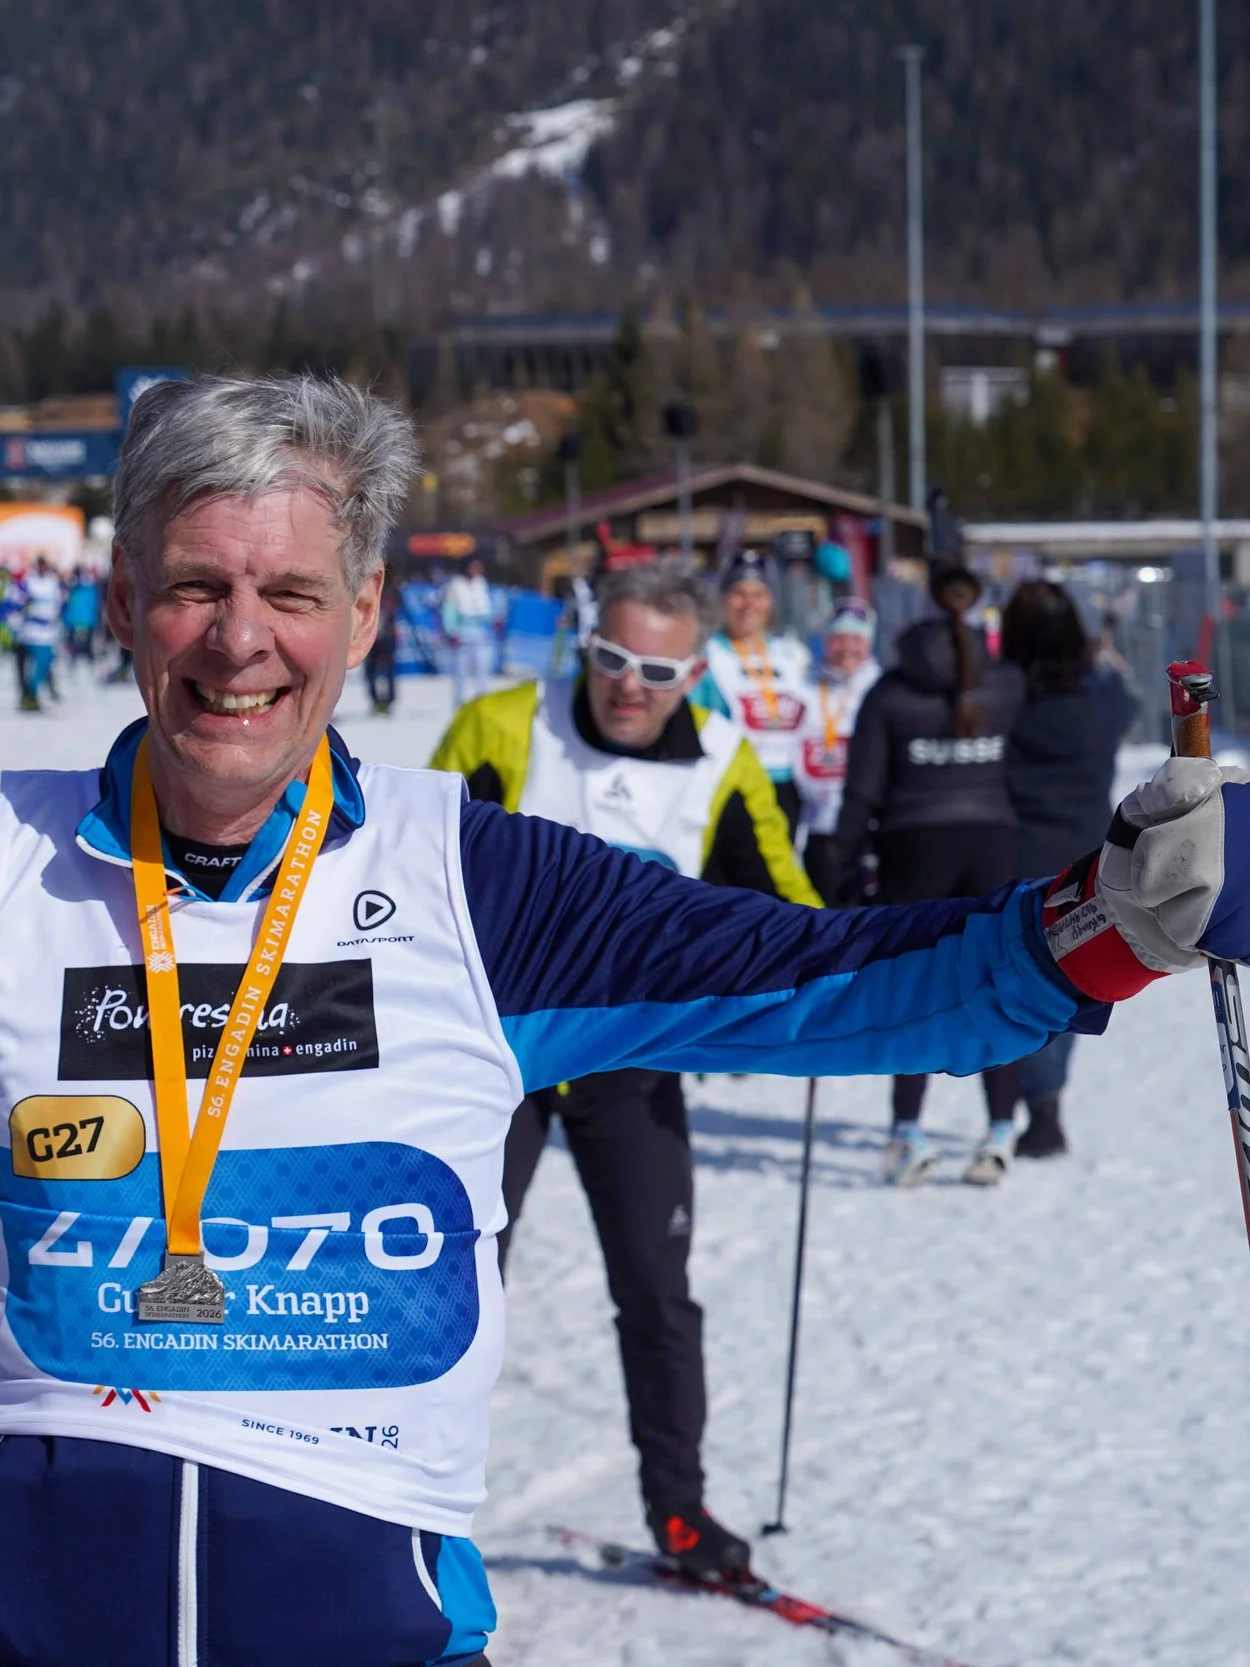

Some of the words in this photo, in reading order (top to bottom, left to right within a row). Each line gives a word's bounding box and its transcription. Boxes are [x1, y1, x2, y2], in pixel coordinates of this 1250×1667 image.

[184, 852, 242, 868] CRAFT
[255, 810, 324, 976] SKIMARATHON
[215, 984, 261, 1089] ENGADIN
[193, 1047, 214, 1062] piz
[295, 1039, 358, 1058] engadin
[207, 1092, 226, 1119] 56.
[156, 1305, 190, 1313] ENGADIN
[196, 1308, 222, 1319] 2026
[246, 1284, 370, 1323] Knapp
[91, 1332, 119, 1350] 56.
[123, 1332, 218, 1350] ENGADIN
[223, 1332, 388, 1351] SKIMARATHON
[241, 1418, 285, 1436] SINCE
[289, 1430, 320, 1445] 1969
